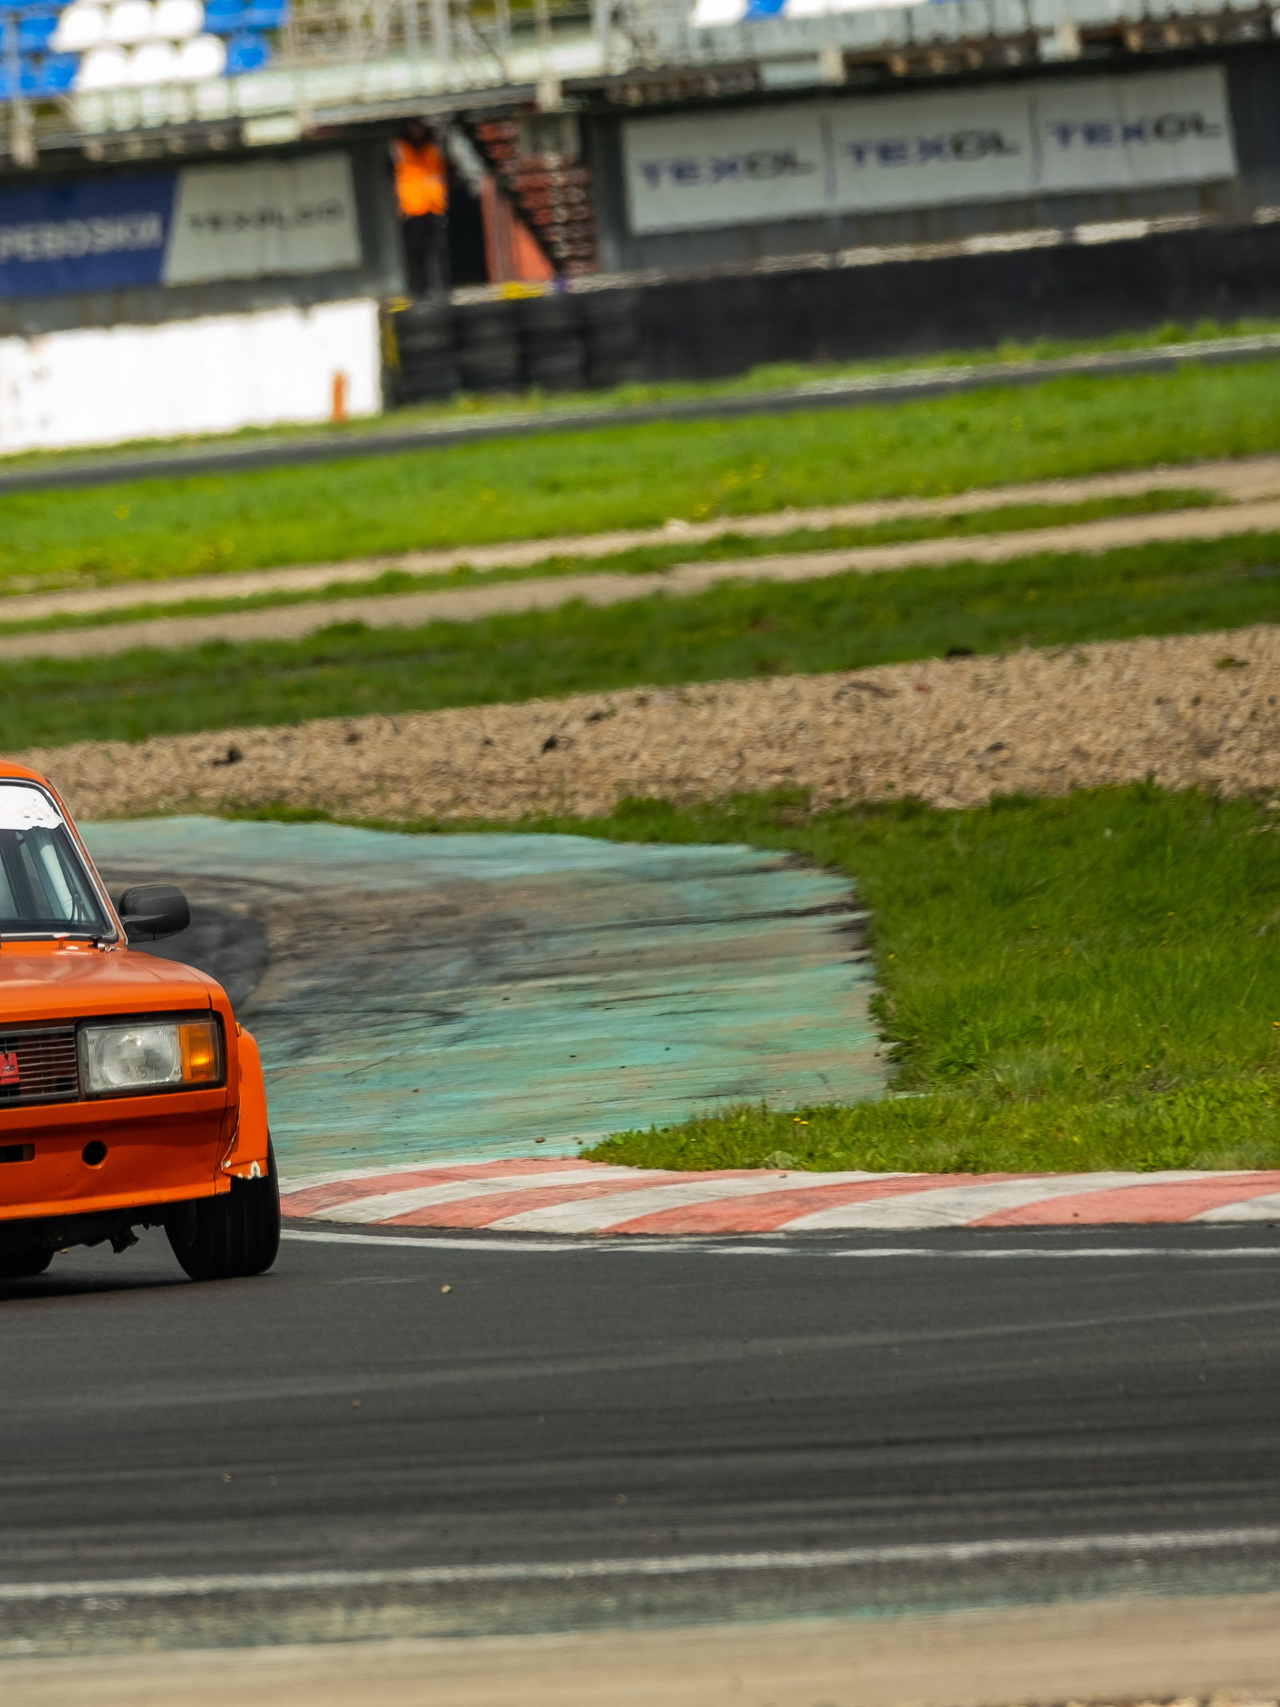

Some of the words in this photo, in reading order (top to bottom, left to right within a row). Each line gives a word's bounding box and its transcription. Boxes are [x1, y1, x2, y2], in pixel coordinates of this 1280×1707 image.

[844, 128, 1023, 170] TEXOL
[1049, 111, 1221, 151] TEXOL
[637, 146, 819, 190] TEXOL
